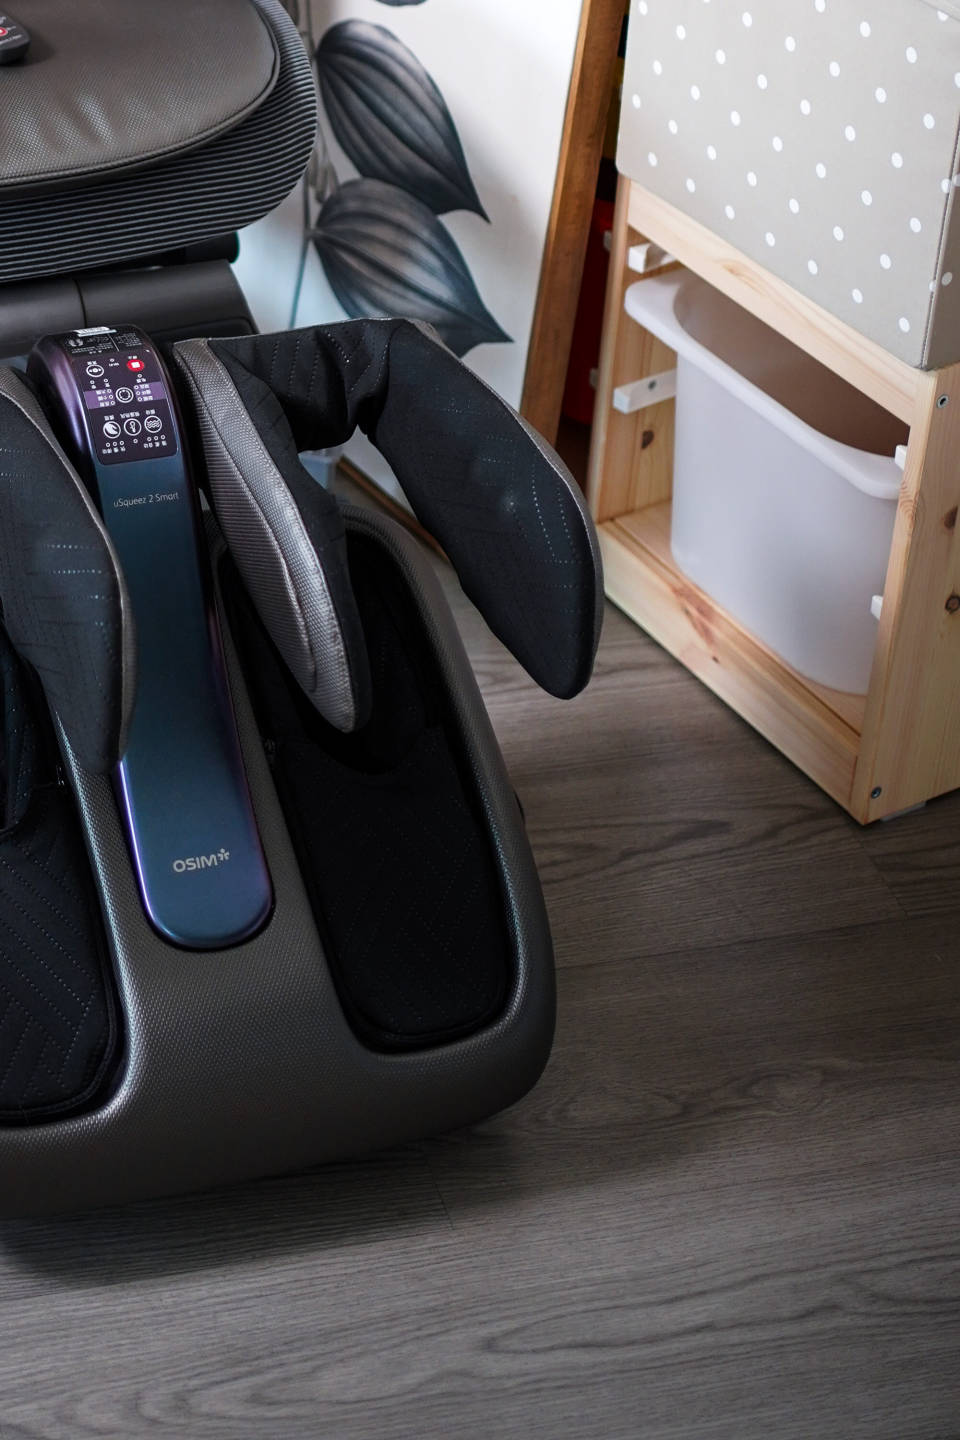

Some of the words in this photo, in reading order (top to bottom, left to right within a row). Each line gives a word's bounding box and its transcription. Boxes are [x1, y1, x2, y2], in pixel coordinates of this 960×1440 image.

[148, 494, 155, 503] 2
[155, 491, 180, 502] Smart
[172, 854, 219, 873] OSIM
